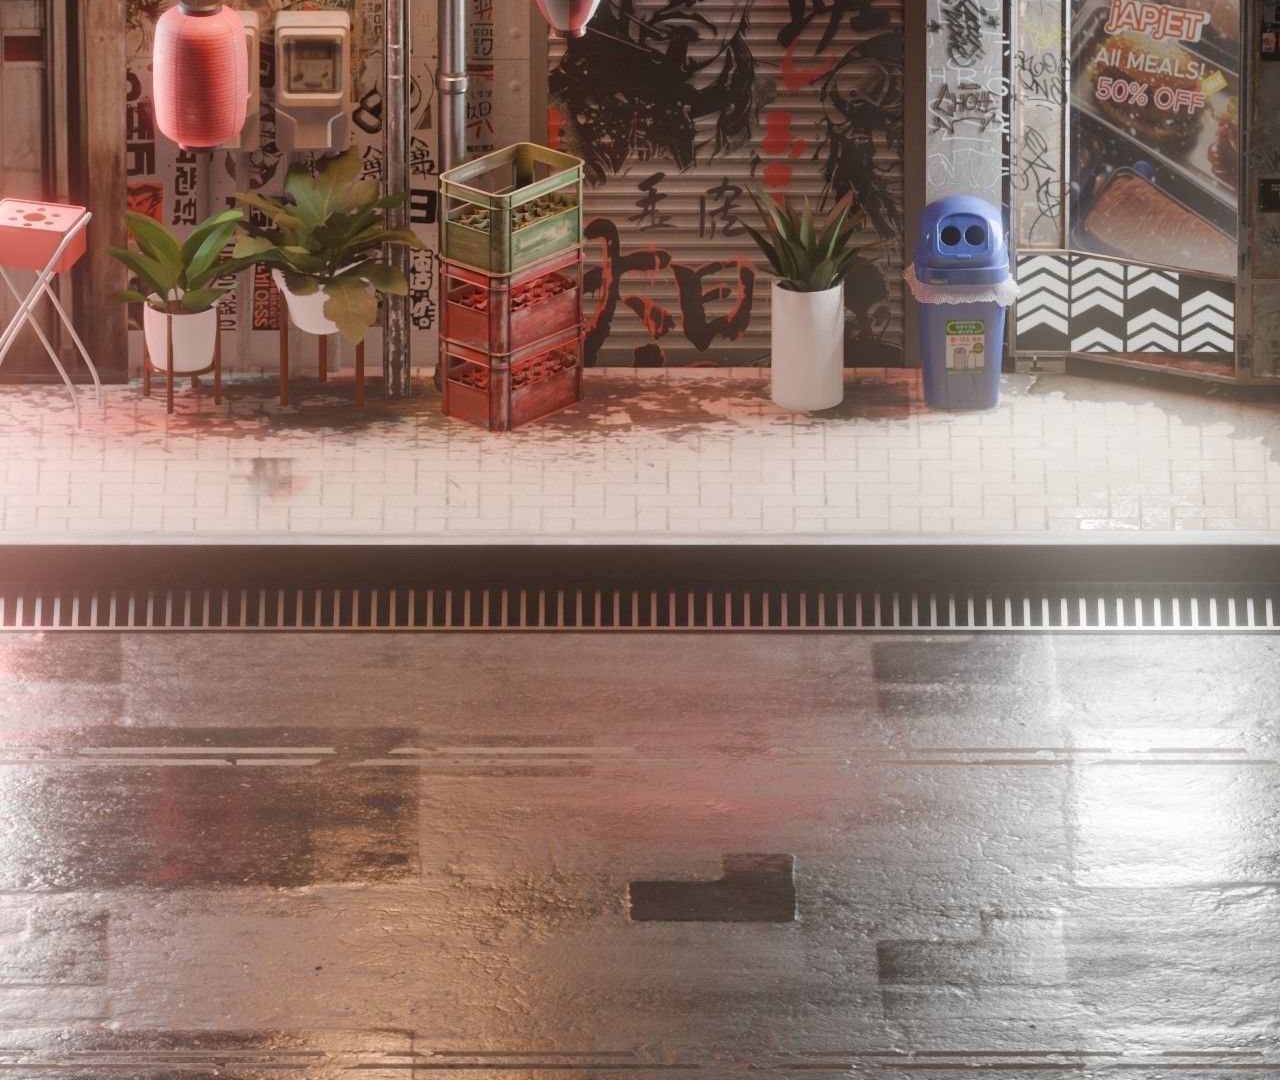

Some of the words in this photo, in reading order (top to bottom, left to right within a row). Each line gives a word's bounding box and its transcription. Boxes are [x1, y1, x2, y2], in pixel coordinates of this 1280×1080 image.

[1126, 51, 1206, 81] MEALS!
[1095, 76, 1149, 107] 50%
[1153, 87, 1207, 115] OFF
